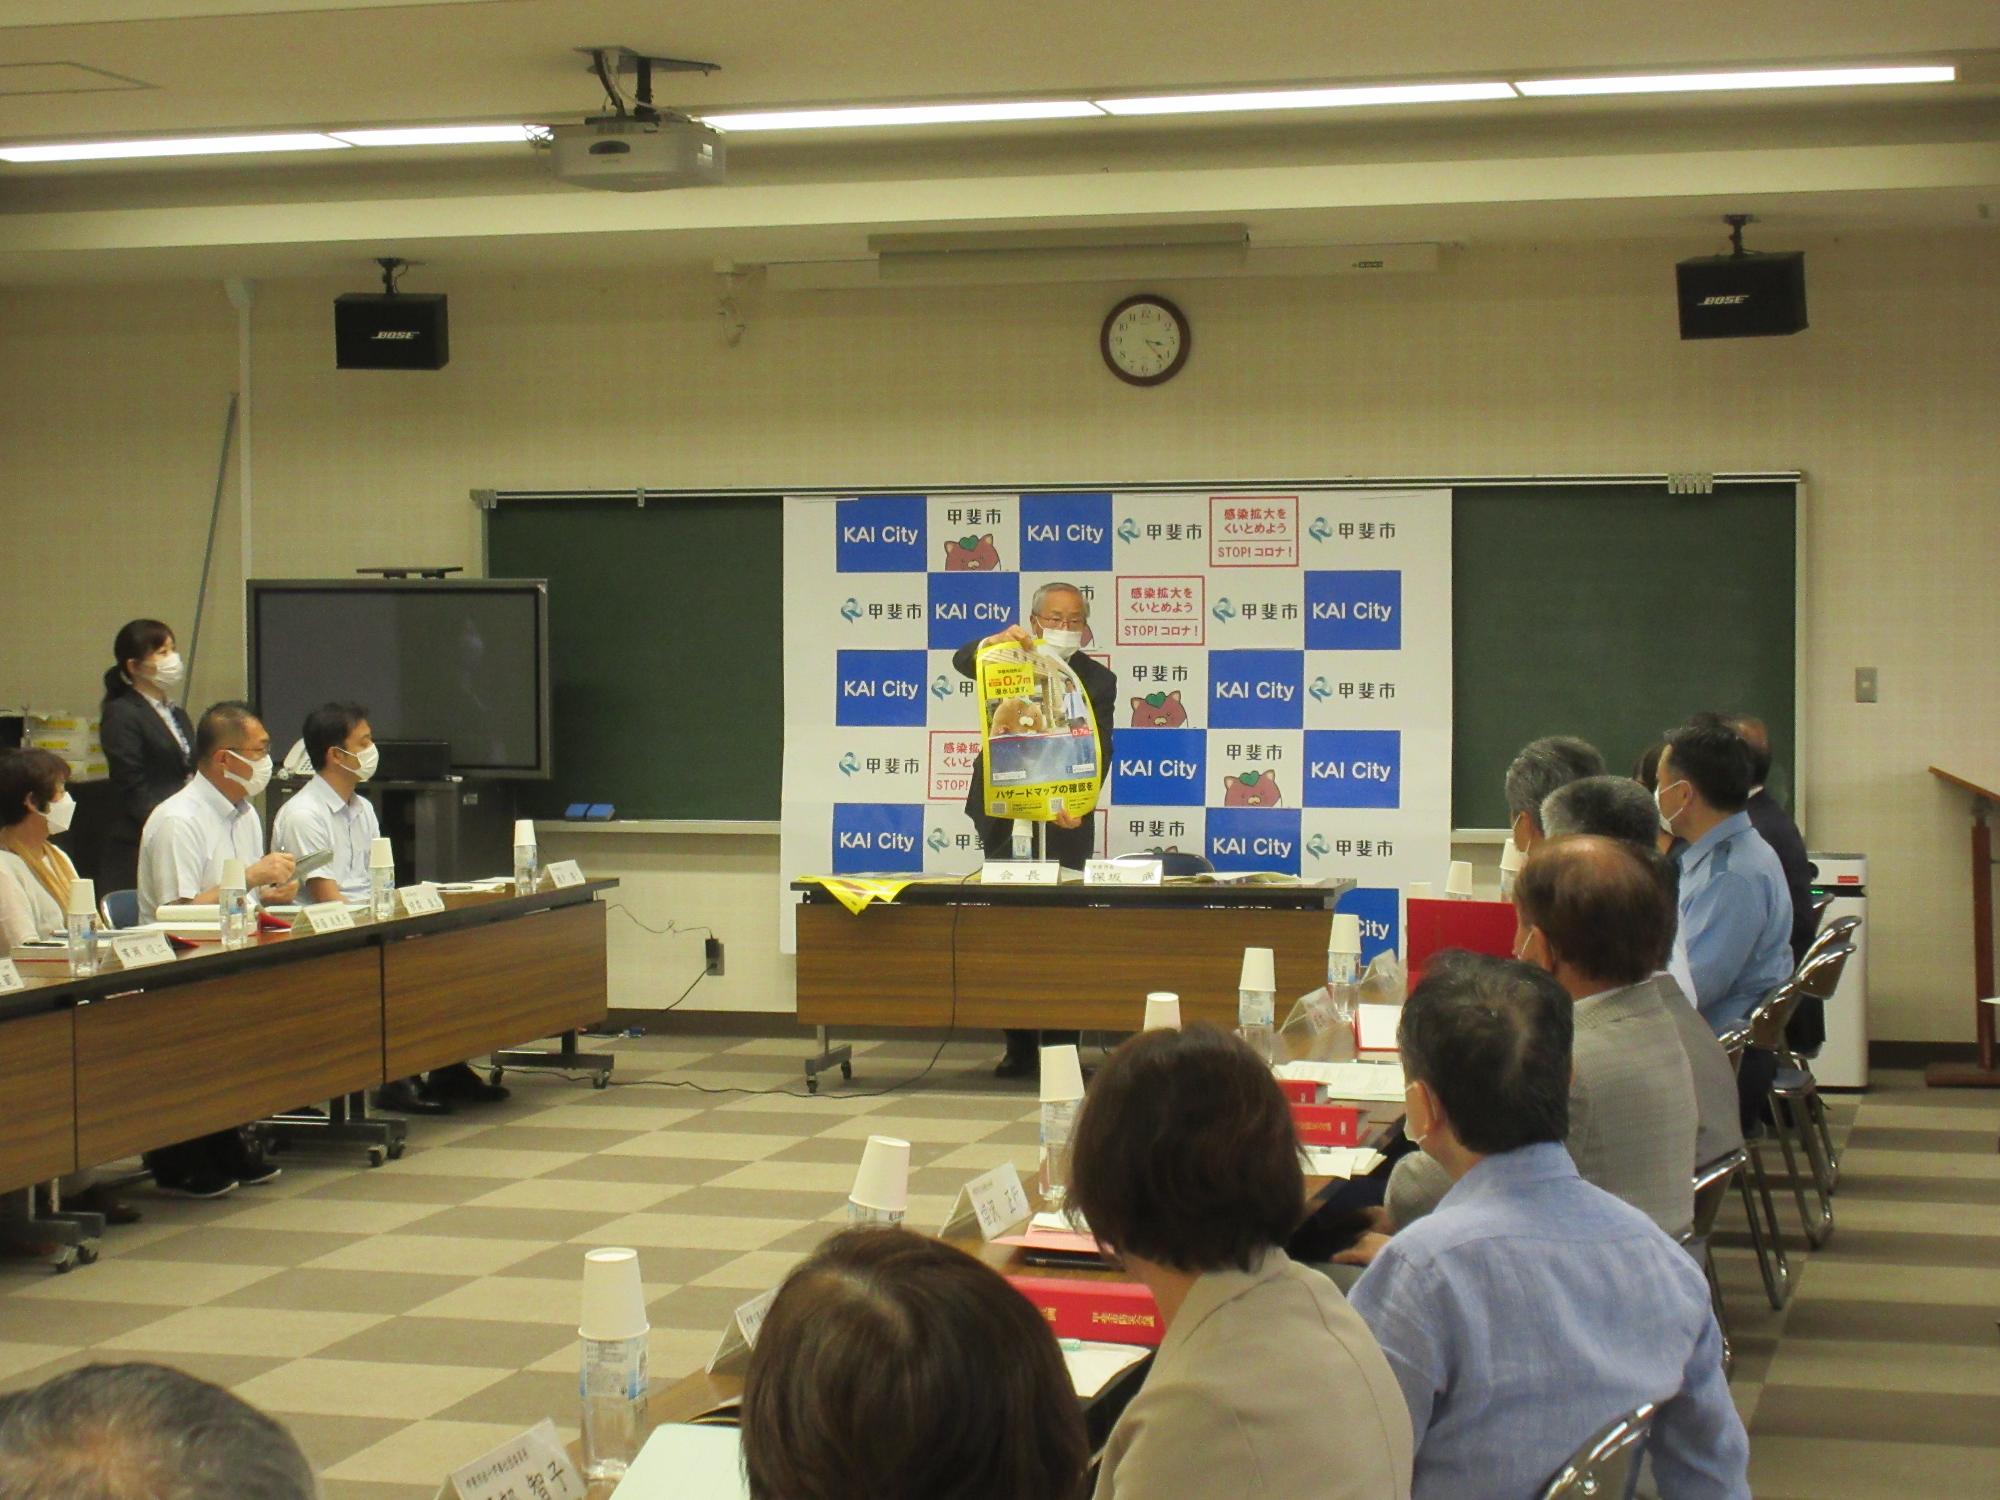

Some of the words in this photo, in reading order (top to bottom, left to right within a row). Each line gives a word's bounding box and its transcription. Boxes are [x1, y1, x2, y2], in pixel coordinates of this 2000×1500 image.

[1697, 295, 1749, 306] BOSE
[369, 331, 420, 339] BOSE
[948, 509, 1000, 525] 甲斐市
[1224, 508, 1286, 520] 感染拡大を
[844, 527, 875, 543] KAI
[882, 526, 918, 545] City
[1028, 525, 1059, 541] KAI
[1067, 524, 1103, 543] City
[1147, 524, 1201, 540] 甲斐市
[1224, 523, 1286, 534] くいとめよう
[1339, 522, 1395, 539] 甲斐市
[1131, 587, 1192, 599] 感染拡大を
[869, 604, 921, 619] 甲斐市
[936, 604, 966, 619] KAI
[974, 603, 1010, 622] City
[1131, 602, 1192, 613] くいとめよう
[1242, 603, 1297, 620] 甲斐市
[1313, 603, 1345, 619] KAI
[1354, 602, 1391, 621] City
[1133, 665, 1187, 681] 甲斐市
[844, 681, 875, 697] KAI
[882, 680, 918, 699] City
[1217, 682, 1248, 698] KAI
[1256, 682, 1294, 701] City
[1339, 682, 1395, 699] 甲斐市
[944, 742, 980, 753] 感染拡
[1227, 744, 1282, 760] 甲斐市
[866, 758, 919, 774] 甲斐市
[944, 757, 973, 767] くいと
[1120, 760, 1152, 776] KAI
[1160, 760, 1197, 779] City
[1311, 762, 1344, 778] KAI
[1352, 762, 1390, 782] City
[996, 782, 1093, 799] ハザードマップの確認を
[1130, 821, 1184, 837] 甲斐市
[840, 832, 870, 848] KAI
[878, 832, 914, 852] City
[956, 834, 985, 850] 甲斐
[1213, 838, 1245, 854] KAI
[1254, 838, 1291, 858] City
[1336, 840, 1392, 857] 甲斐市
